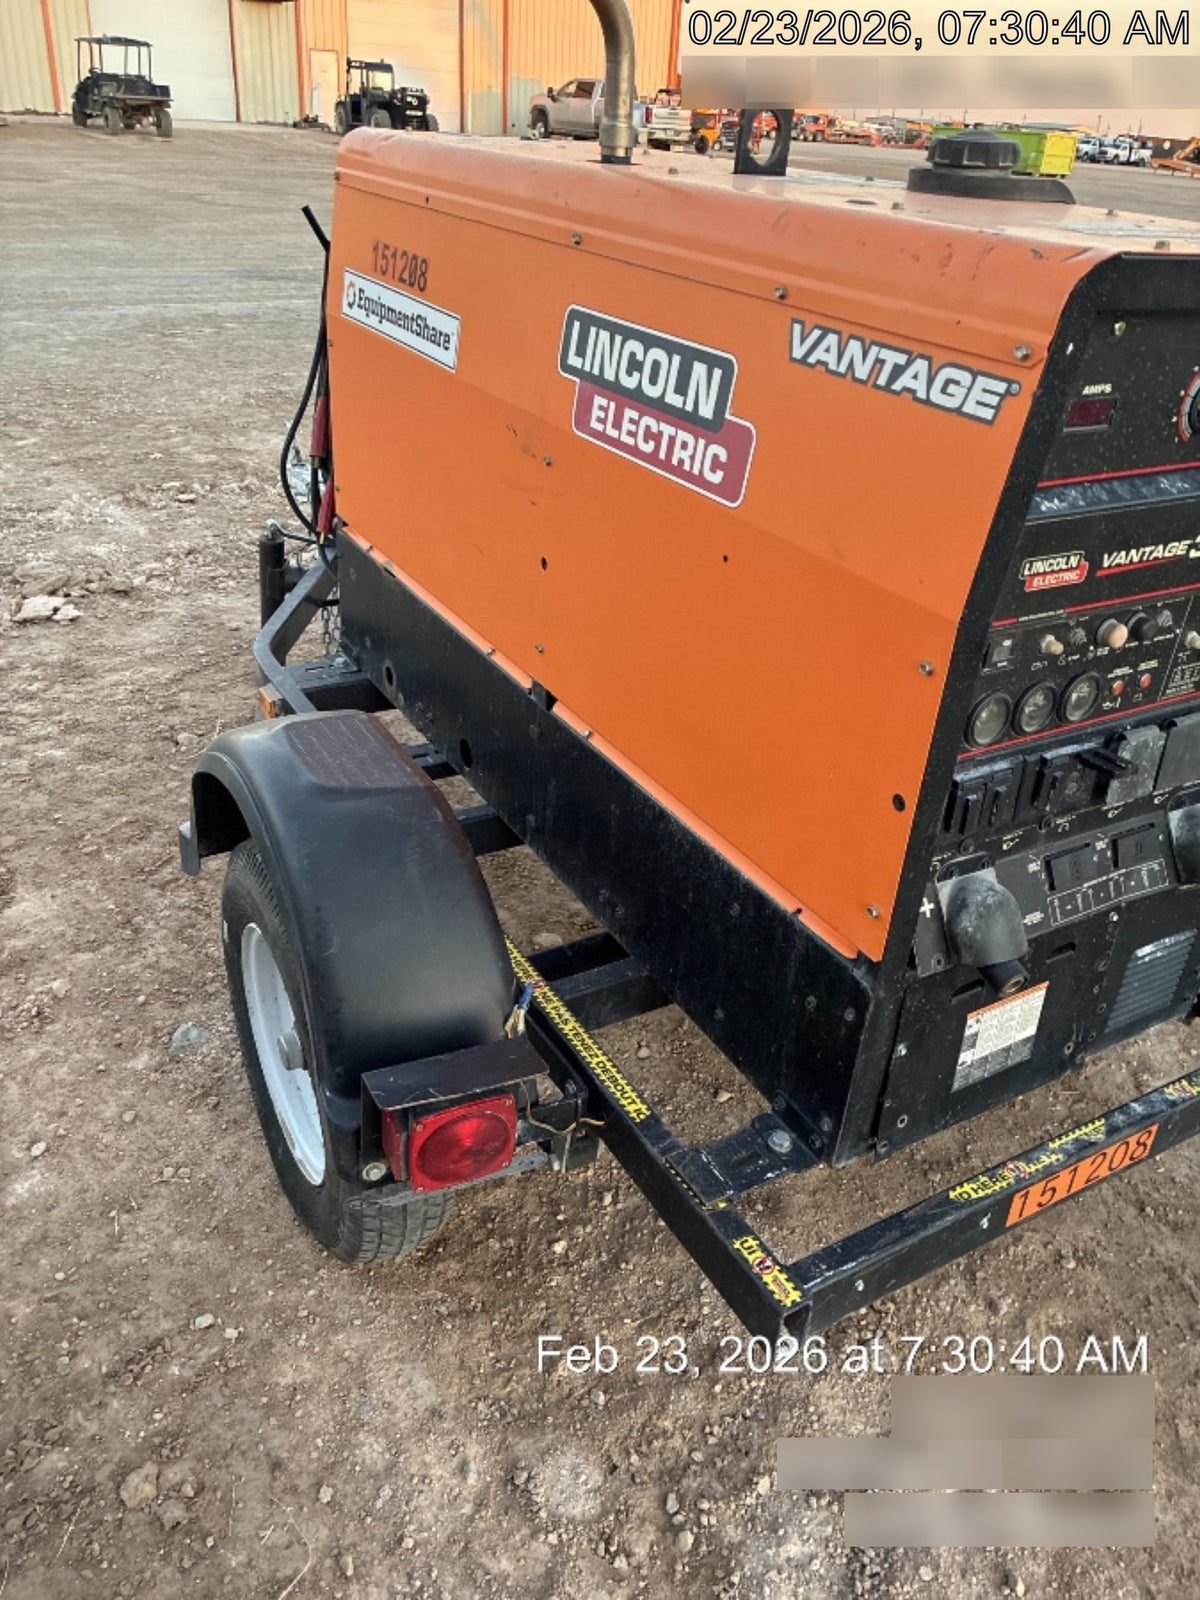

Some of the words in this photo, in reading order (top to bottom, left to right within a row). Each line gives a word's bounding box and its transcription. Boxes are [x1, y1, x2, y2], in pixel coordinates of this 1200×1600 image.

[372, 240, 429, 293] 151208
[356, 287, 452, 351] EquipmentShare
[566, 319, 723, 420] LINCOLN
[1082, 383, 1112, 395] AMPS
[589, 394, 728, 485] ELECTRIC
[1024, 554, 1080, 576] LINCOLN
[1102, 539, 1193, 568] VANTAGE
[1033, 570, 1081, 587] ELECTRIC
[595, 1060, 638, 1107] DEBOUT
[971, 1171, 1011, 1196] HERE
[1018, 1129, 1153, 1219] 151208
